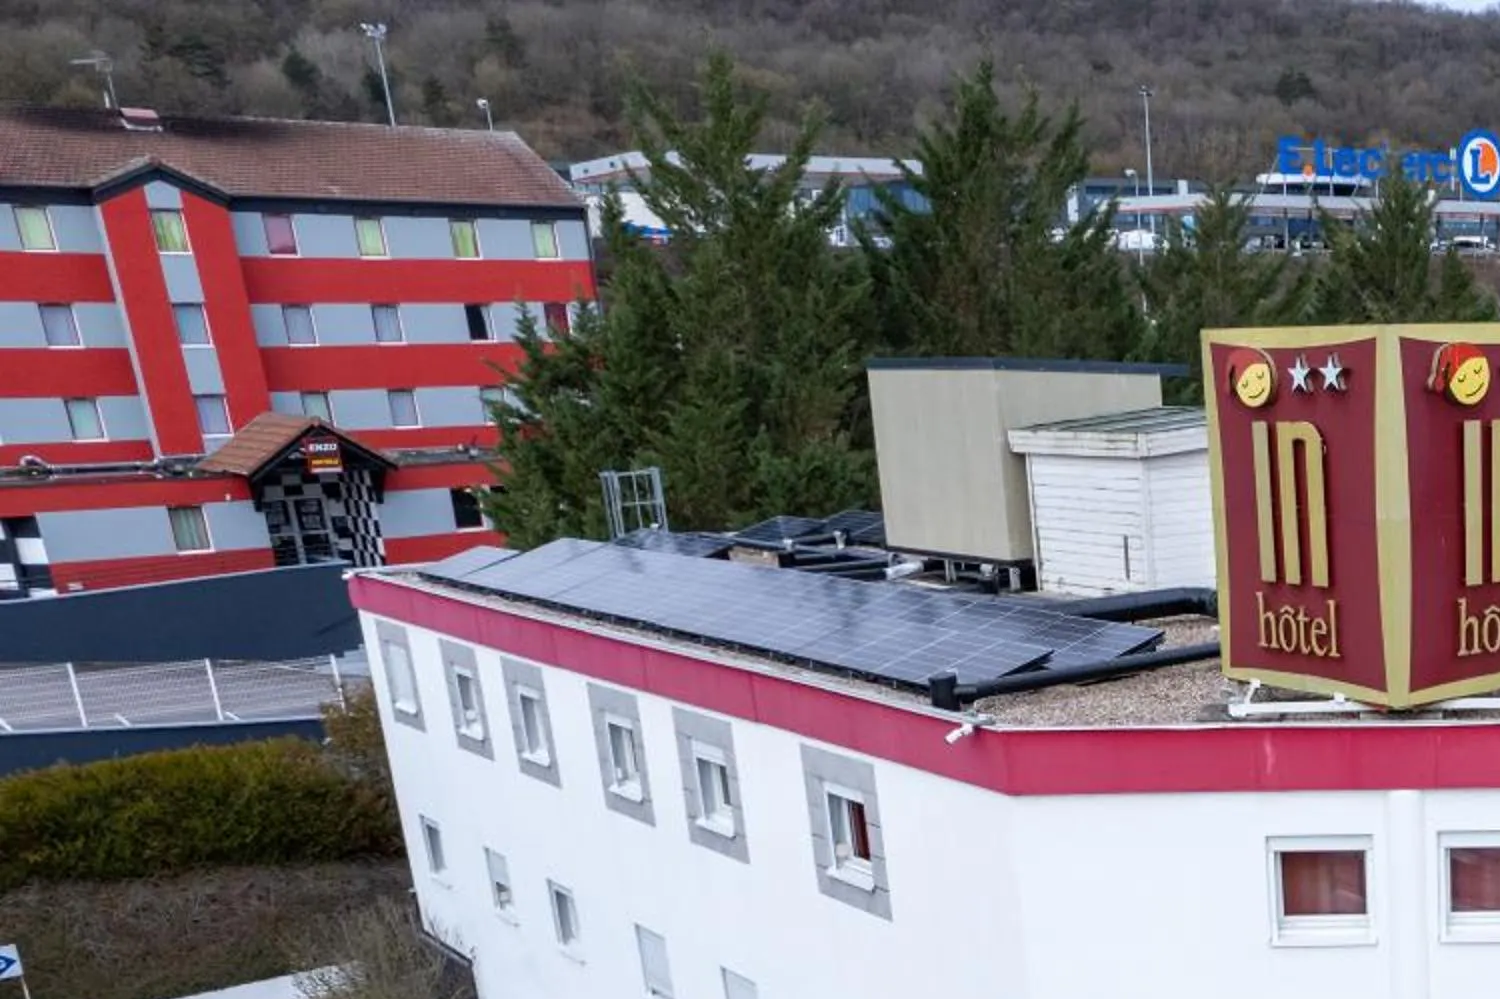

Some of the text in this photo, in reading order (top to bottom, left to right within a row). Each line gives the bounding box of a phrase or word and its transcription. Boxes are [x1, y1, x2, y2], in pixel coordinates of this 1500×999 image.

[1278, 135, 1452, 182] E.Lecerc
[1252, 420, 1330, 588] in
[1256, 591, 1341, 658] hôtel
